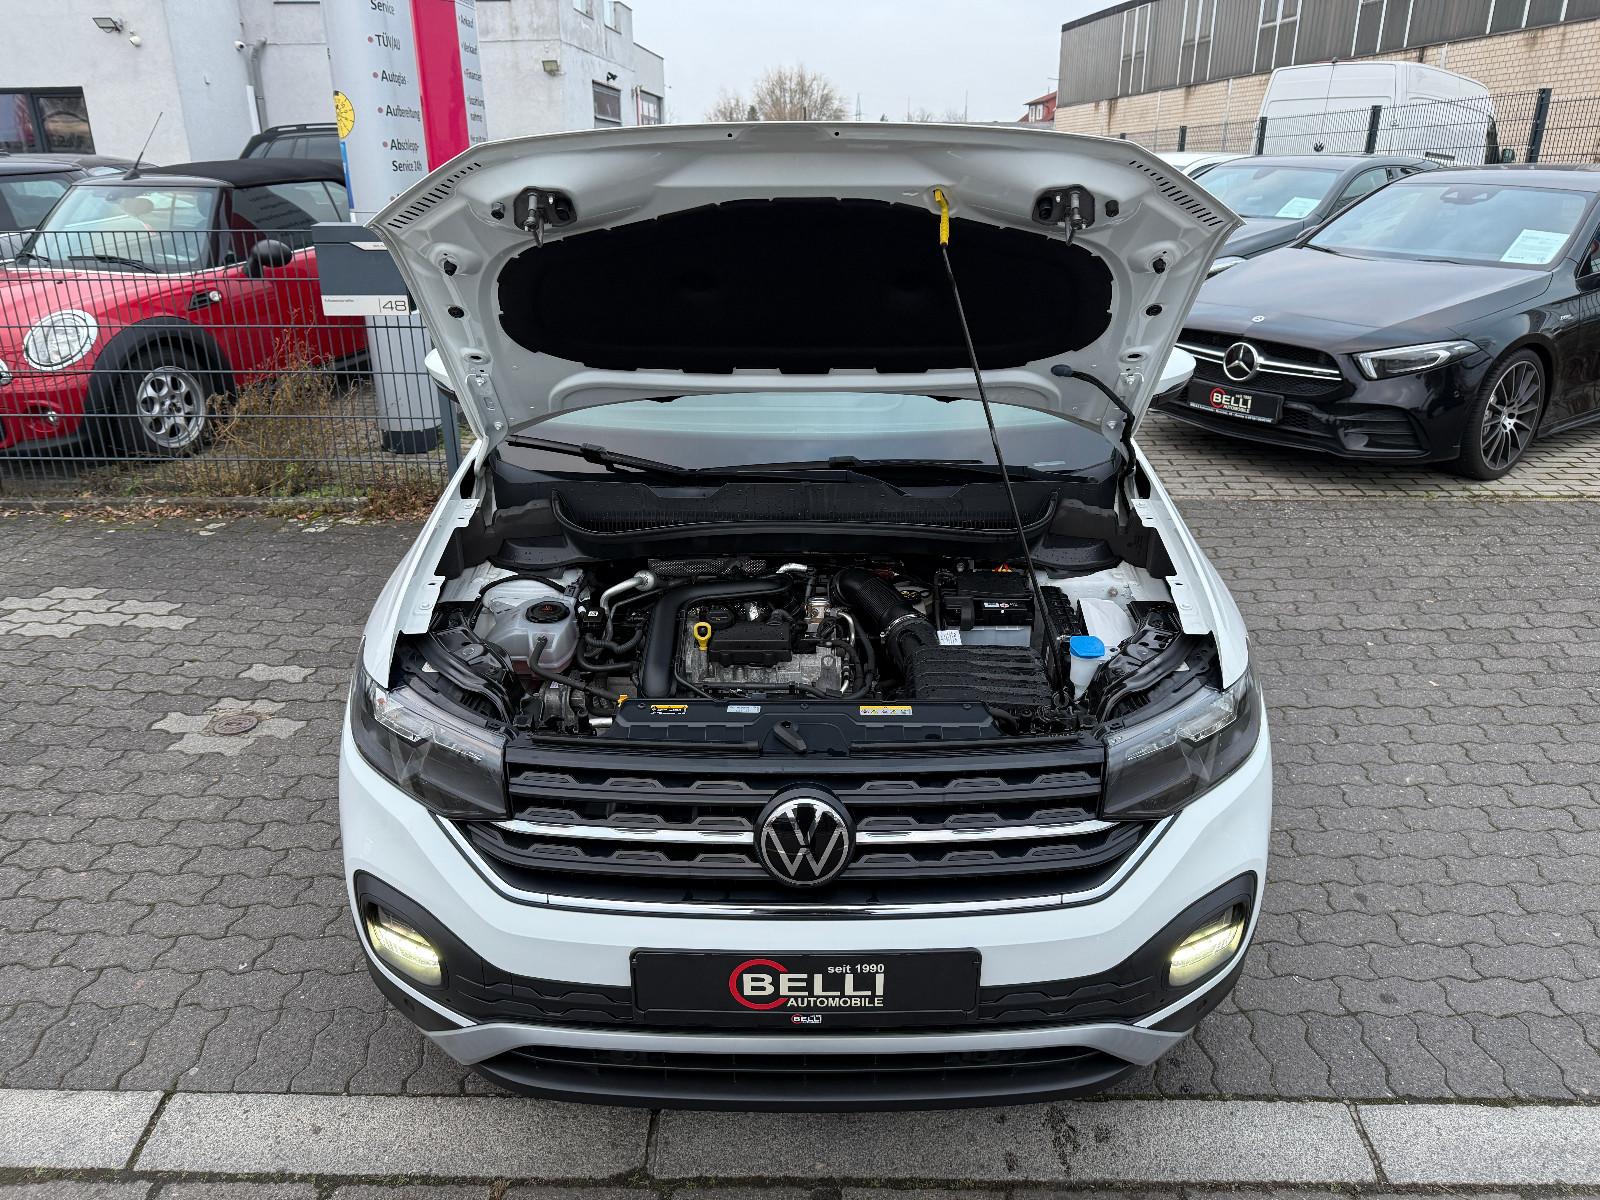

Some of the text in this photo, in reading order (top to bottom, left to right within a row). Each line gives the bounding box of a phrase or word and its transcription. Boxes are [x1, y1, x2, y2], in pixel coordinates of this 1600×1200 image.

[370, 0, 395, 15] Service
[382, 300, 407, 312] 48
[1212, 392, 1252, 409] BELLI
[827, 963, 885, 974] seit 1990
[743, 973, 885, 996] BELLI
[787, 997, 884, 1007] AUTOMOBILE
